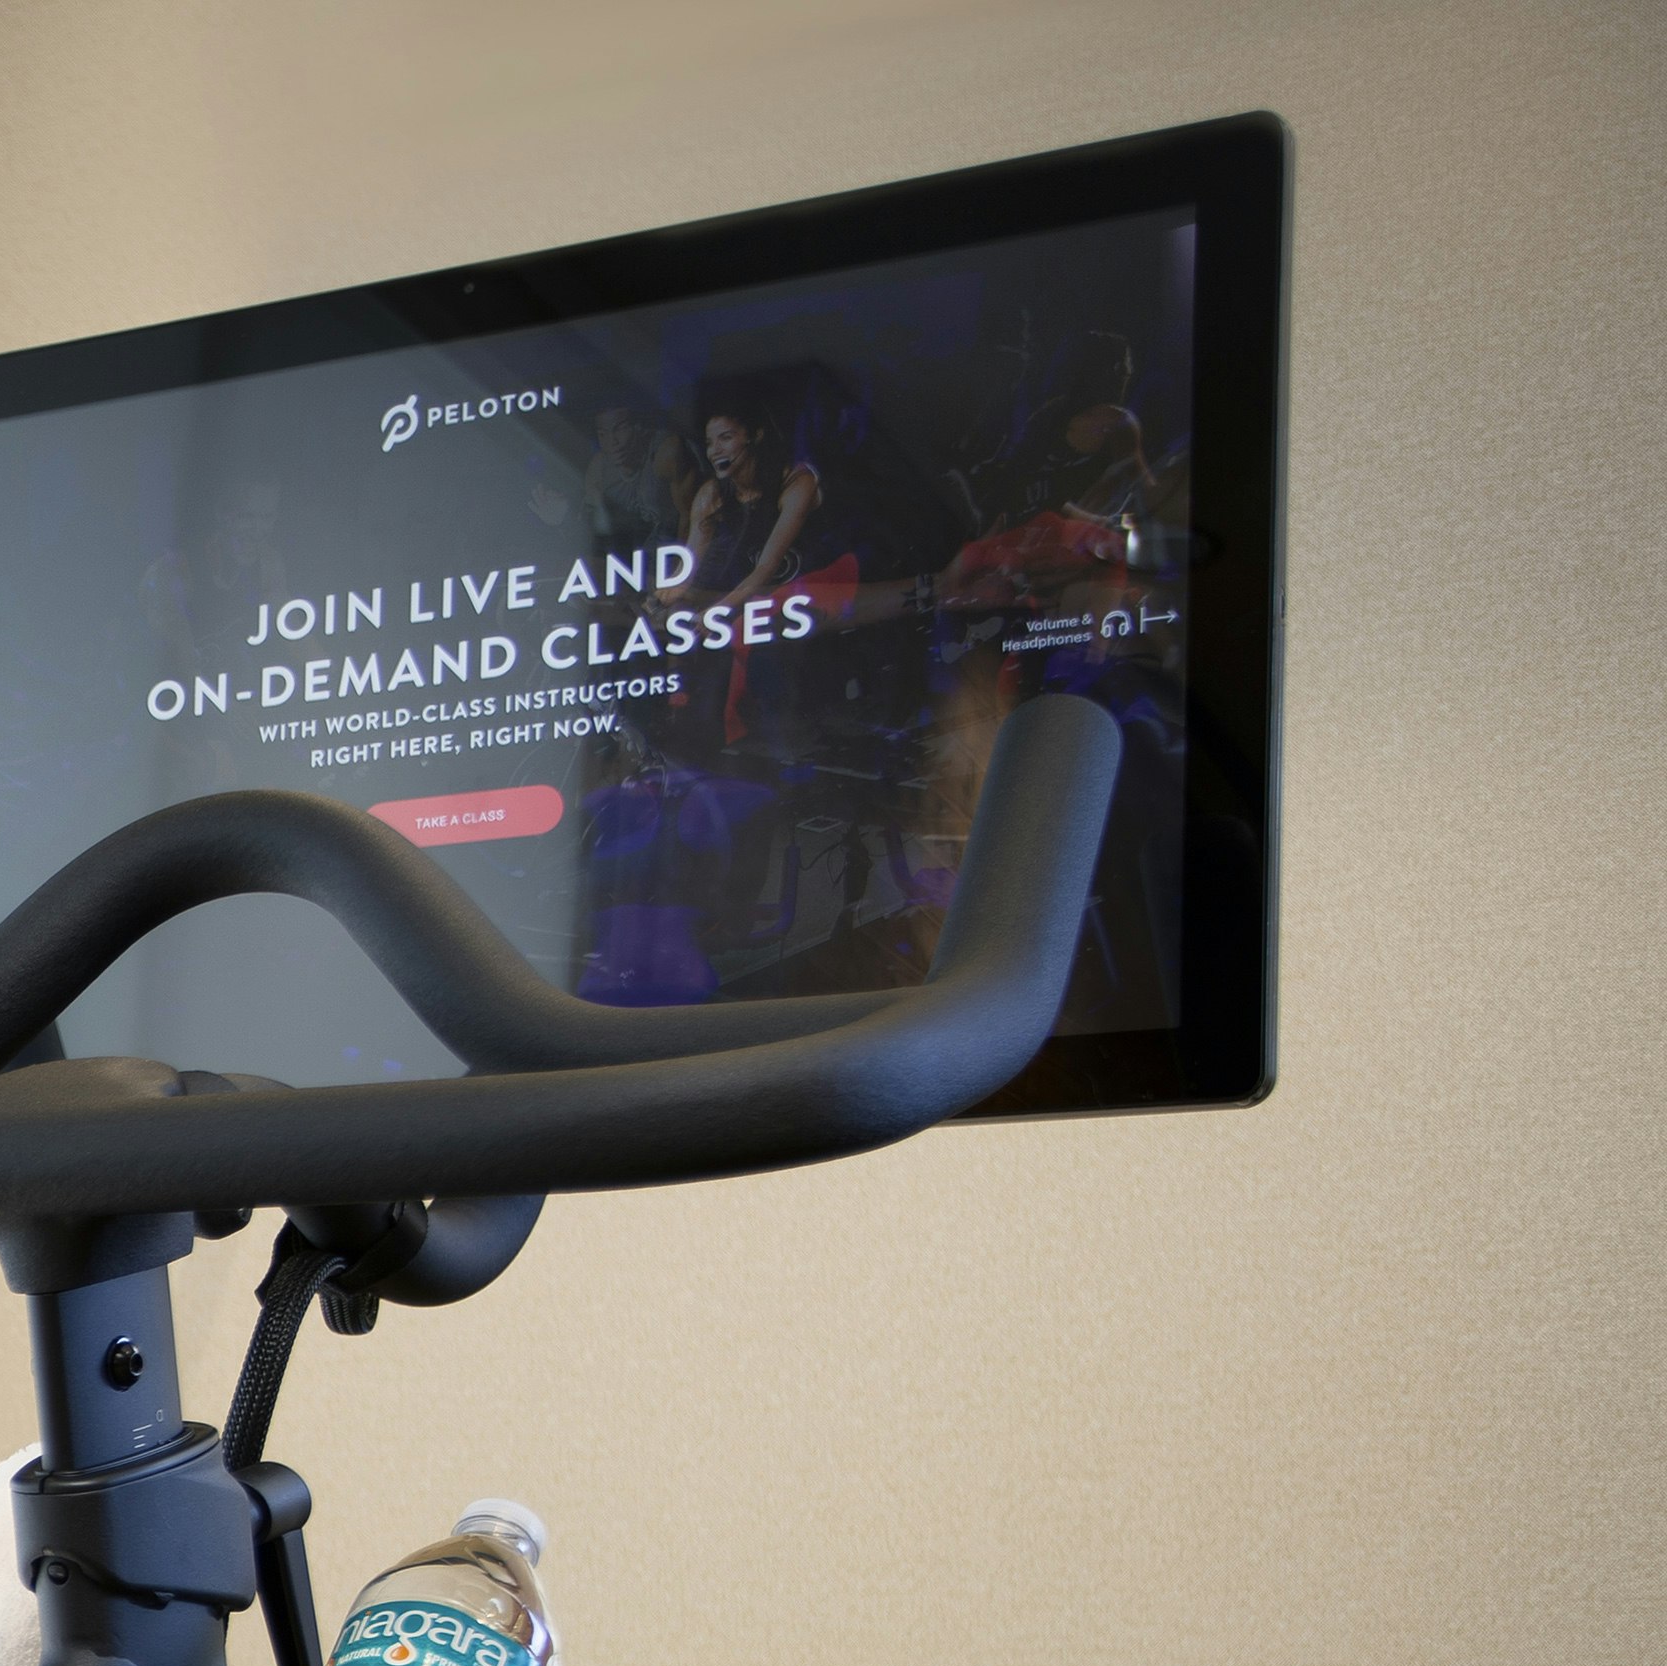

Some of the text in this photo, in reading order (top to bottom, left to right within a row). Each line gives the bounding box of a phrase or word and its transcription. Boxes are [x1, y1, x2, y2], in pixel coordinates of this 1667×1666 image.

[427, 386, 560, 428] PELOTON
[246, 545, 695, 646] JOIN LIVE AND
[1002, 631, 1092, 652] Headphones
[1026, 613, 1092, 633] Volume &
[147, 595, 813, 721] ON-DEMAND CLASSES
[259, 674, 681, 744] WITH WORLD-CLASS INSTRUCTORS
[311, 713, 622, 768] RIGHT HERE, RIGHT NOW.
[415, 809, 506, 830] TAKE A CLASS
[336, 1647, 382, 1666] NATURAL
